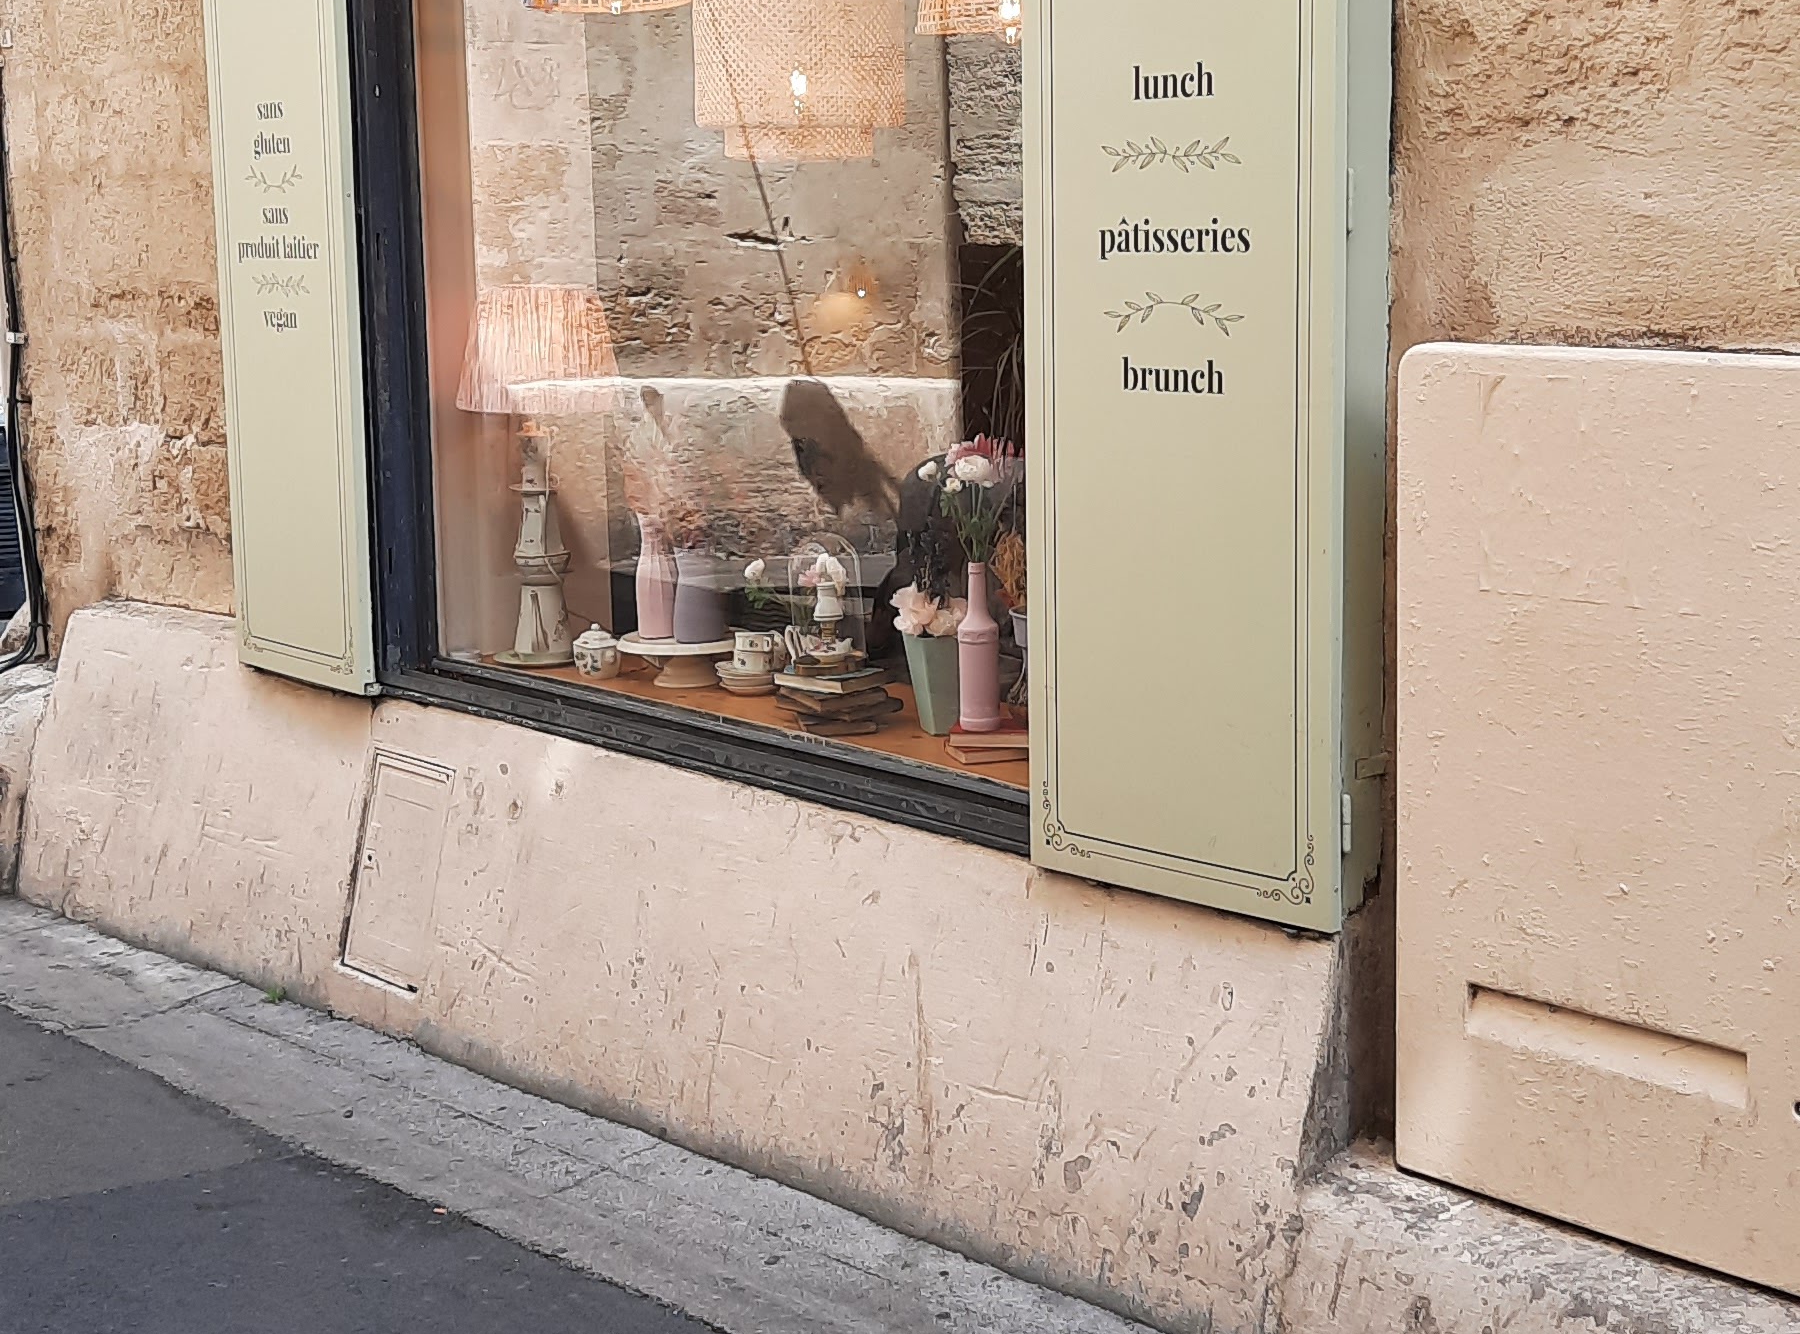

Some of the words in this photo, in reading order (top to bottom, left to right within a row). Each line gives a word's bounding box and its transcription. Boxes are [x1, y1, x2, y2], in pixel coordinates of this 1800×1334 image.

[1132, 60, 1215, 101] lunch
[256, 101, 284, 121] sans
[253, 131, 291, 161] gluten
[262, 207, 289, 225] sans
[237, 235, 281, 264] produit
[282, 234, 320, 260] laitier
[1098, 216, 1251, 261] pâtisseries
[263, 309, 298, 333] vegan
[1121, 356, 1225, 395] brunch
